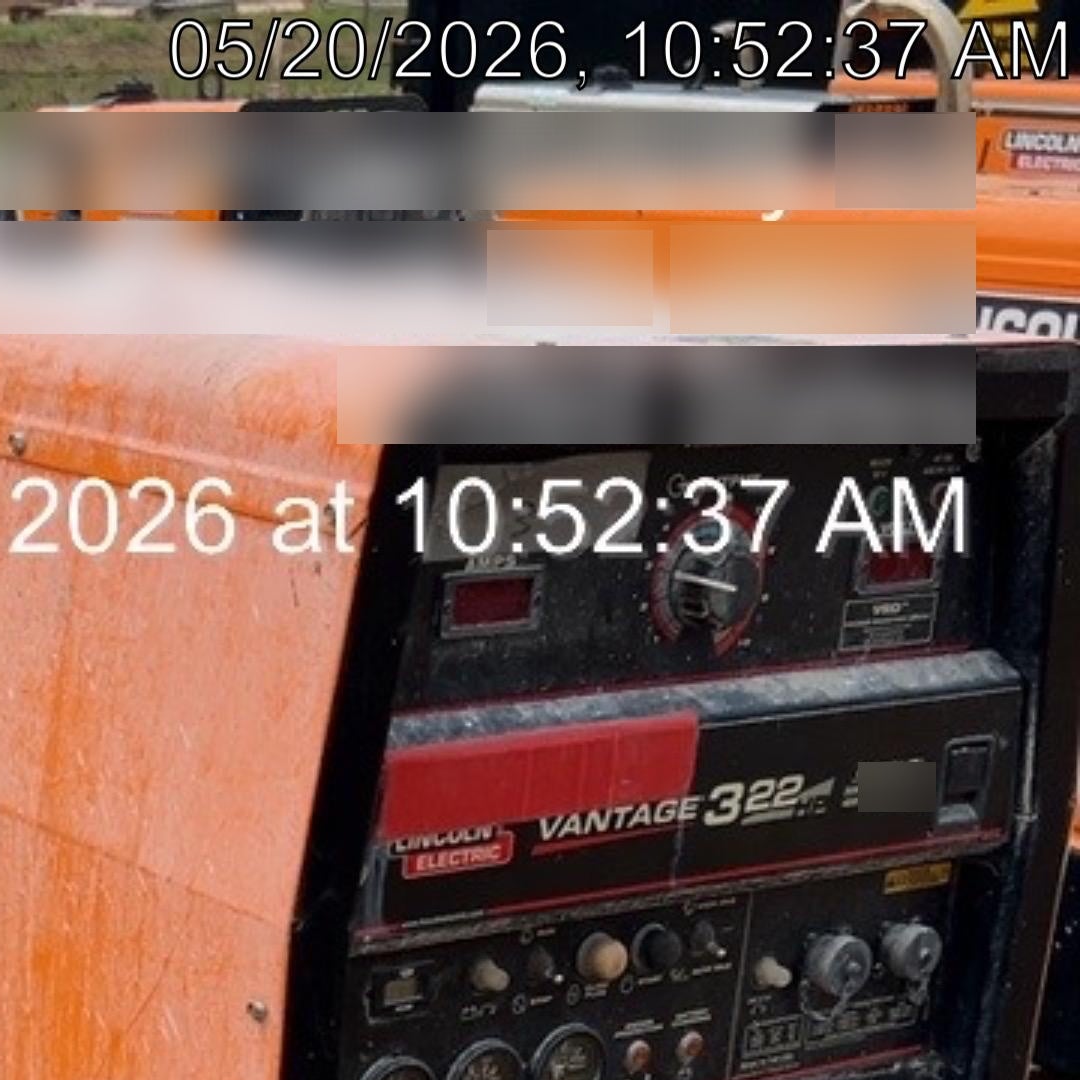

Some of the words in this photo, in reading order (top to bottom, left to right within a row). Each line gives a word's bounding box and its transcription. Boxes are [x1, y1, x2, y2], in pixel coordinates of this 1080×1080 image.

[538, 794, 705, 841] VANTAGE
[703, 774, 806, 826] 322
[416, 844, 502, 872] ELECTRIC
